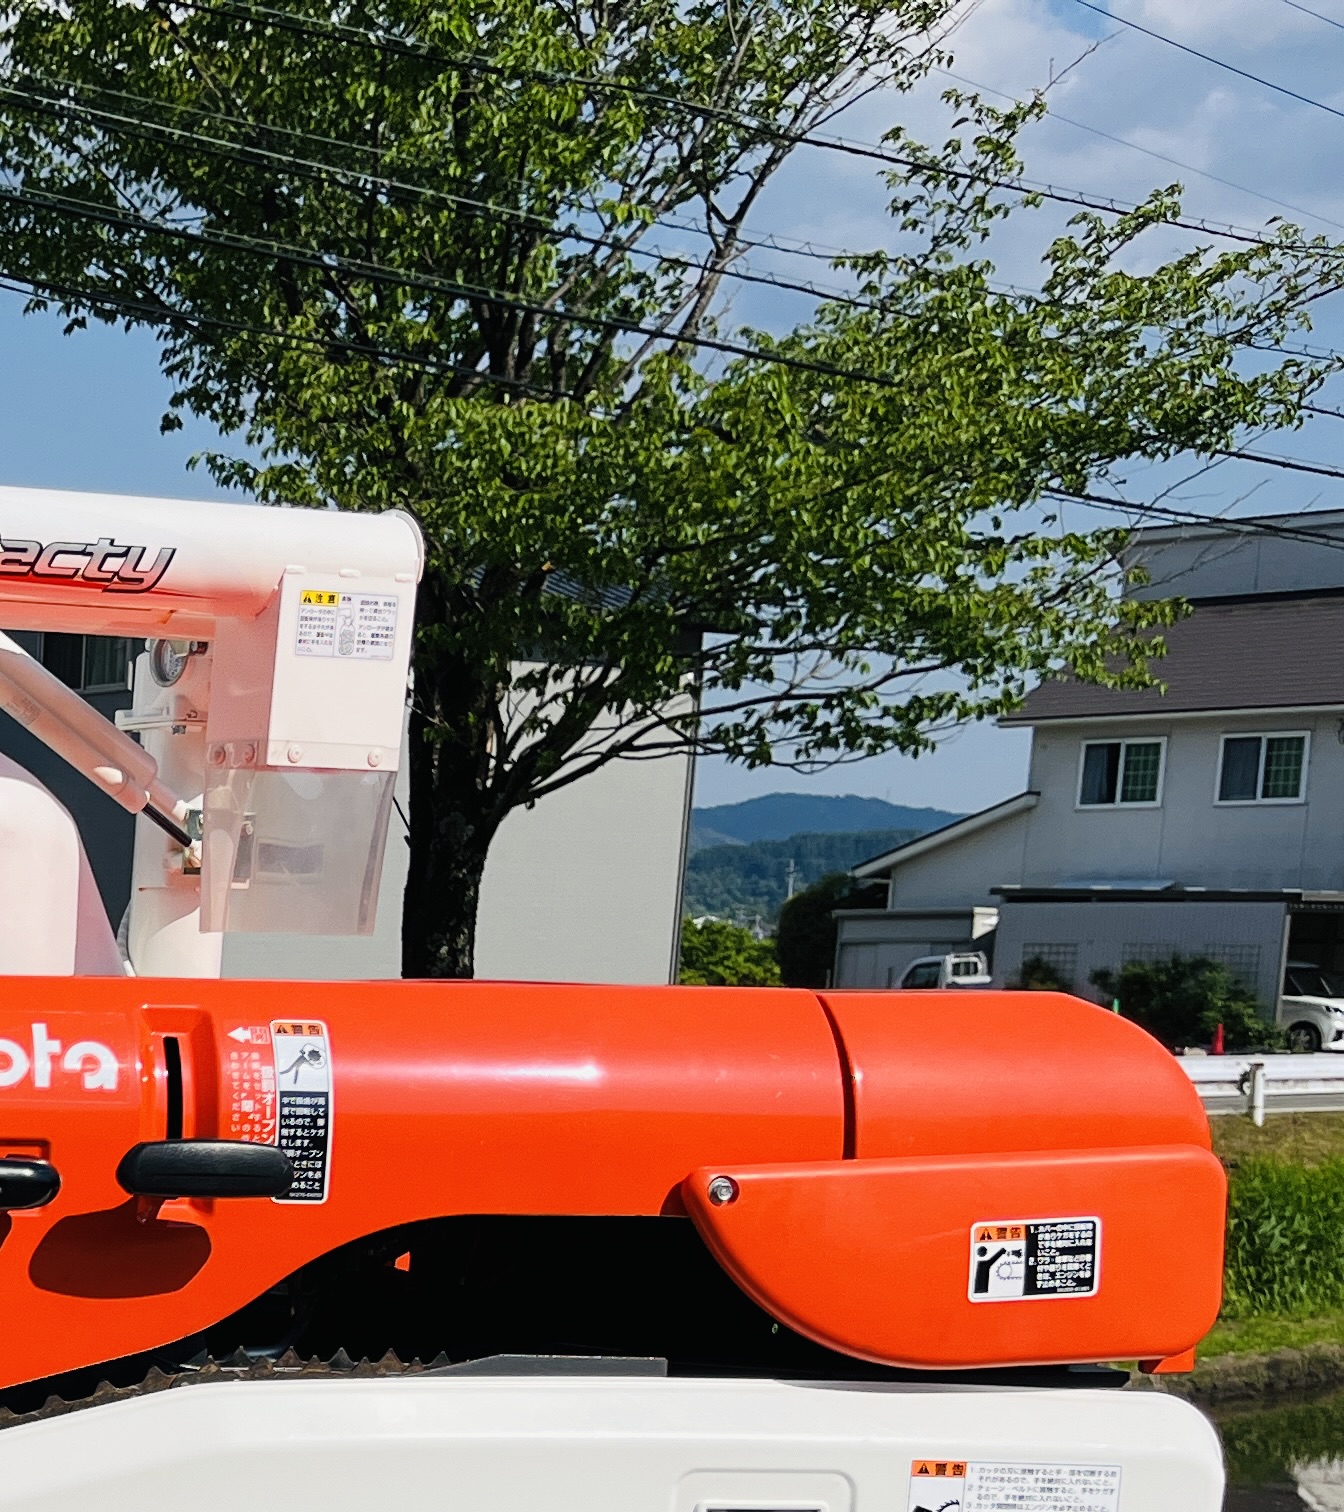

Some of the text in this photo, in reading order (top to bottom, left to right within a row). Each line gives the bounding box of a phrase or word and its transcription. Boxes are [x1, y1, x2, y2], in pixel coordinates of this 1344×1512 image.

[292, 1024, 320, 1036] 警告
[996, 1227, 1021, 1239] 警告
[935, 1463, 964, 1476] 警告
